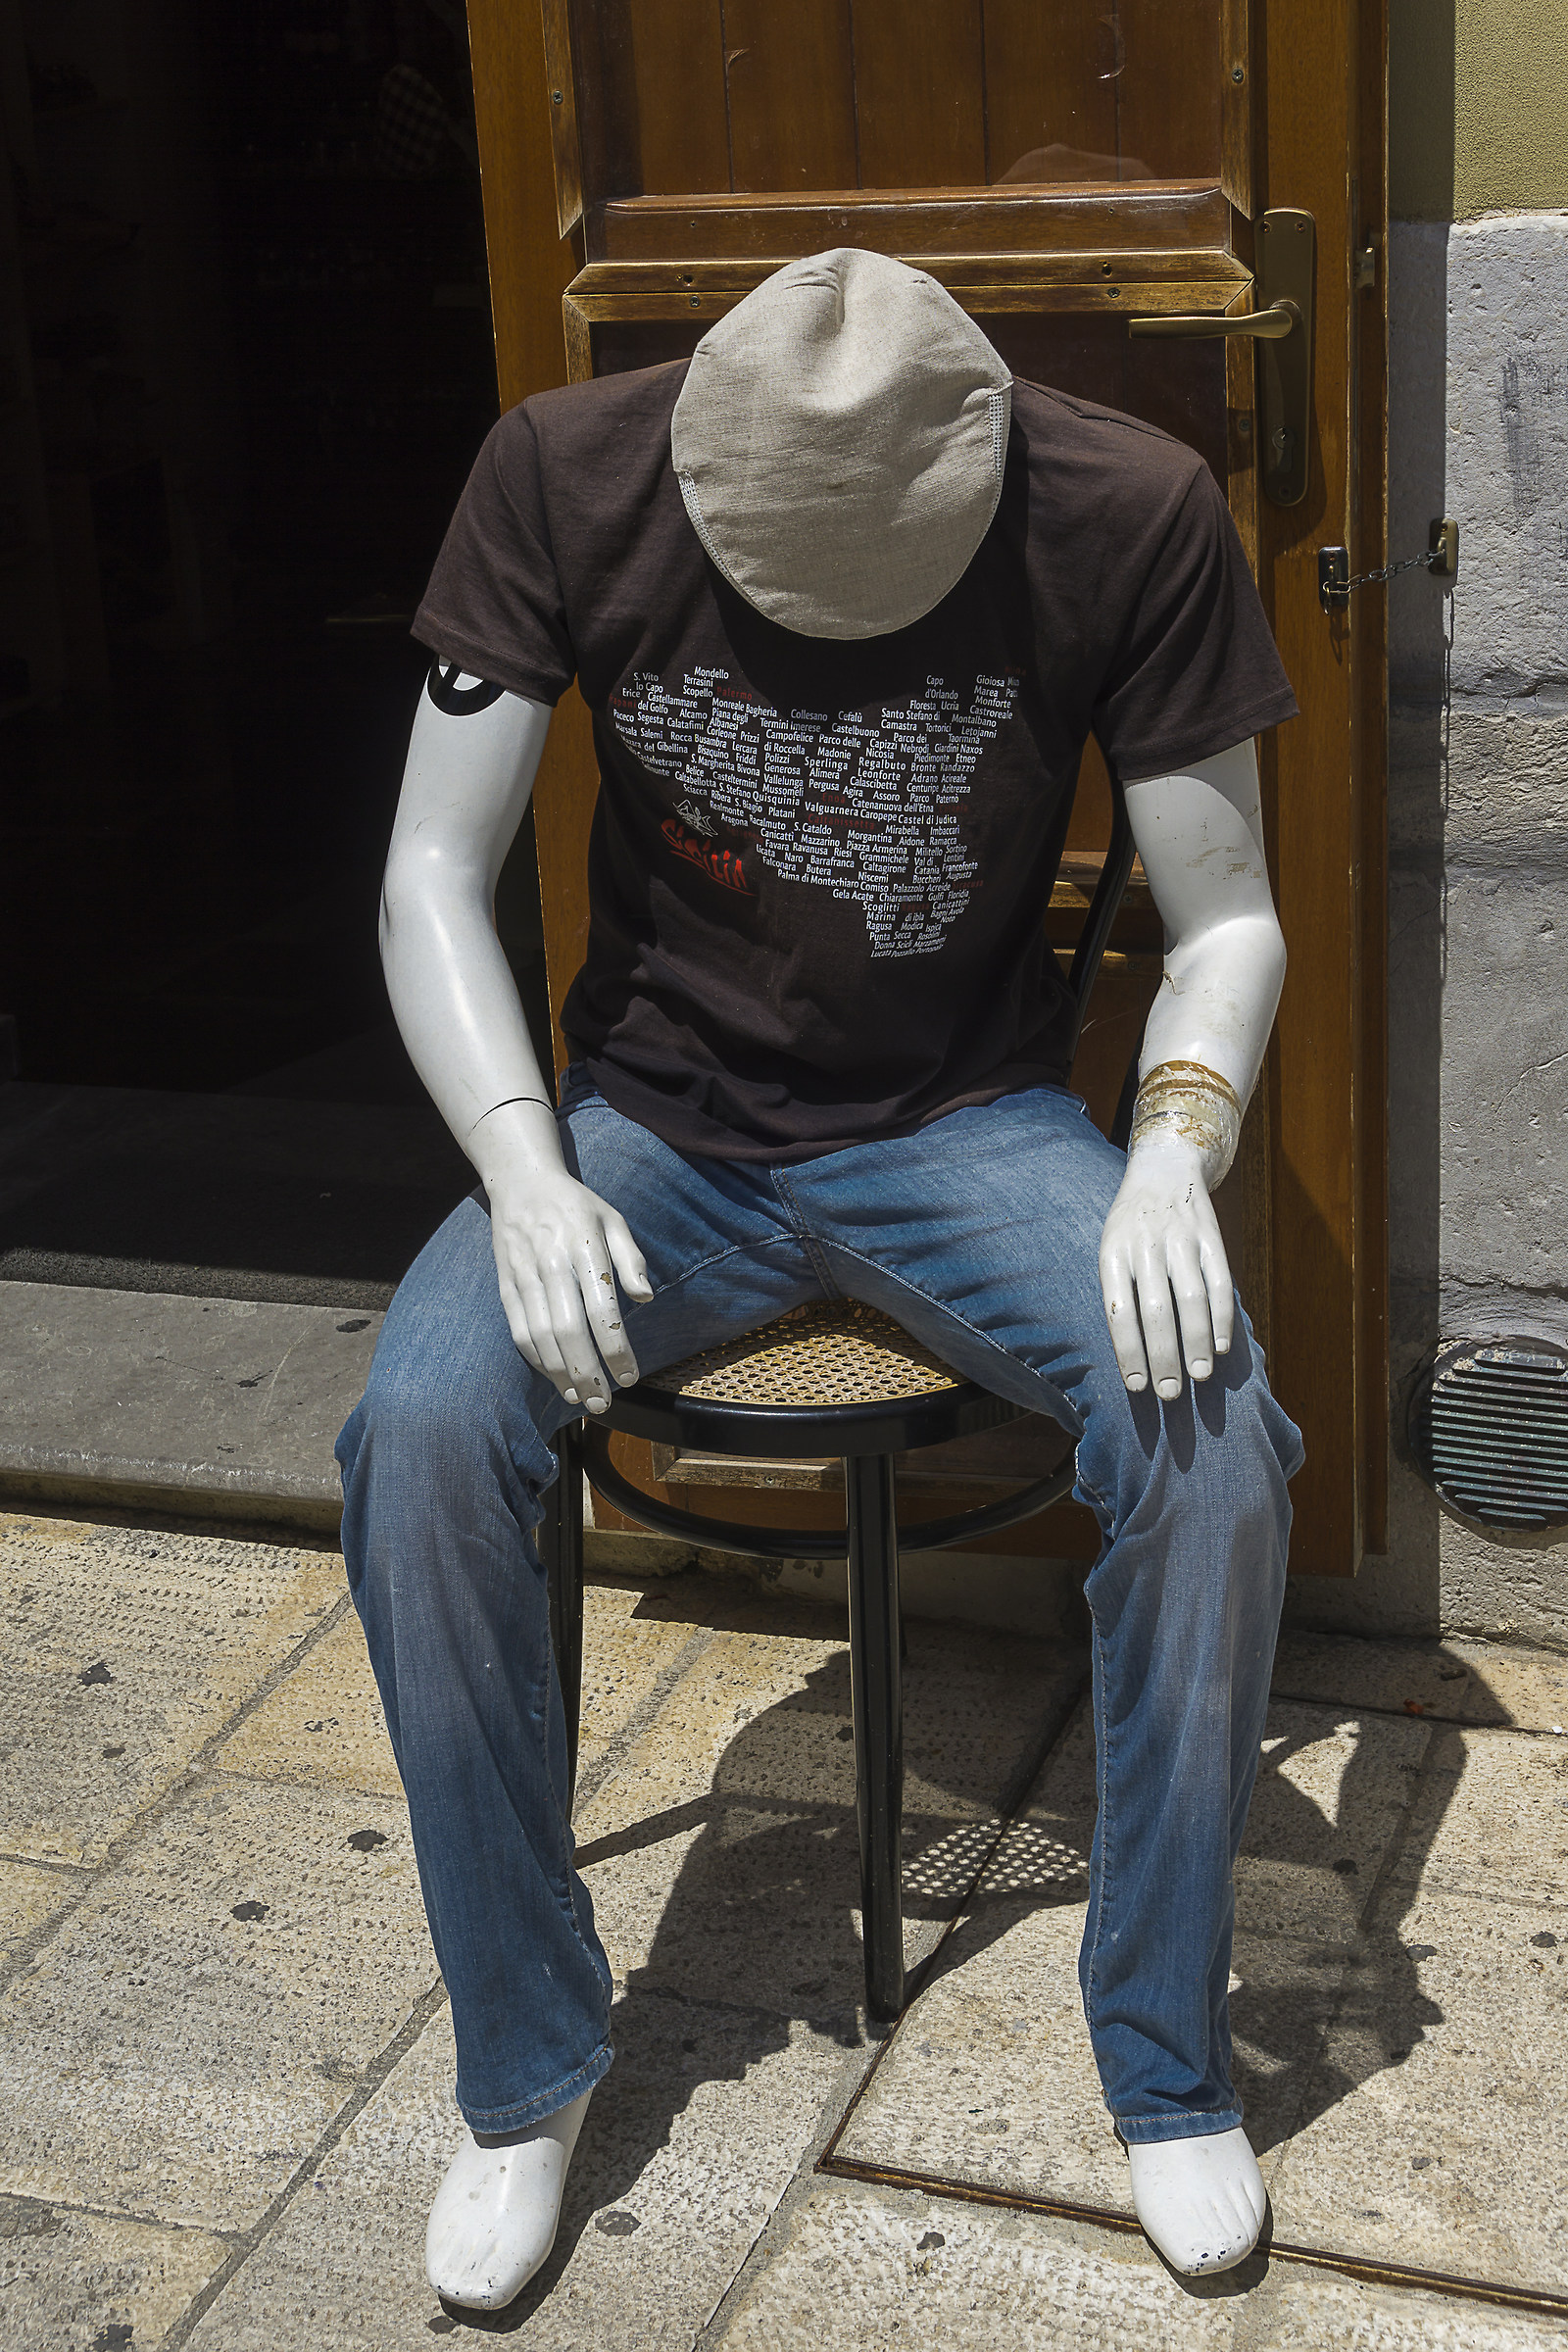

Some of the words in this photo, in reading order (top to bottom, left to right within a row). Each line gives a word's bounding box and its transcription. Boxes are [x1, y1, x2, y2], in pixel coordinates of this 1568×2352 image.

[643, 672, 659, 682] Vito
[683, 674, 713, 687] Terrasini
[694, 666, 729, 679] Mondello
[976, 674, 1005, 687] Gioiosa
[646, 682, 663, 693] Capo
[926, 675, 944, 687] Capo
[622, 688, 640, 698] Erice
[648, 692, 698, 709] Castellammare
[683, 685, 713, 698] Scopello
[974, 685, 999, 697] Marea
[711, 697, 745, 710] Monreale
[746, 704, 777, 717] Bagheria
[909, 700, 936, 710] Floresta
[941, 702, 959, 710] Ucria
[970, 705, 1013, 719] Castroreale
[975, 696, 1011, 709] Monforte
[650, 704, 668, 714] Golfo
[679, 709, 708, 719] Alcamo
[711, 708, 731, 719] Piana
[732, 710, 749, 725] degli
[791, 709, 827, 721] Collesano
[838, 710, 862, 723] Cefalù
[881, 708, 905, 719] Santo
[906, 710, 932, 721] Stefano
[952, 713, 997, 728] Montalbano
[638, 711, 663, 725] Segesta
[667, 717, 704, 730] Calatafimi
[710, 717, 739, 731] Albanesi
[760, 717, 788, 730] Termini
[790, 720, 820, 732] Imerese
[832, 722, 879, 738] Castelbuono
[881, 718, 917, 731] Camastra
[925, 722, 952, 732] Tortorici
[640, 728, 663, 740] Salemi
[671, 731, 692, 742] Rocca
[695, 734, 727, 749] Busambra
[707, 725, 736, 740] Corleone
[740, 731, 760, 743] Prizzi
[766, 729, 813, 743] Campofelice
[819, 733, 841, 745] Parco
[843, 739, 860, 748] delle
[869, 738, 897, 750] Capizzi
[894, 732, 914, 744] Parco
[949, 733, 980, 744] Taormina
[657, 741, 688, 754] Gibellina
[732, 741, 758, 755] Lercara
[774, 743, 805, 755] Roccella
[817, 746, 851, 760] Madonie
[865, 747, 895, 760] Nicosia
[901, 744, 929, 754] Nebrodi
[935, 743, 958, 753] Giardini
[960, 745, 983, 755] Naxos
[698, 756, 734, 771] Margherita
[737, 763, 760, 776] Bivona
[736, 754, 757, 764] Friddi
[764, 753, 790, 763] Polizzi
[805, 757, 848, 771] Sperlinga
[858, 757, 906, 770] Regalbuto
[910, 762, 936, 772] Bronte
[940, 763, 975, 772] Randazzo
[914, 753, 950, 762] Piedimonte
[956, 754, 976, 763] Etneo
[686, 764, 704, 776] Belice
[712, 771, 758, 789] Casteltermini
[764, 762, 801, 775] Generosa
[809, 767, 840, 779] Alimera
[858, 767, 901, 781] Leonforte
[911, 774, 938, 783] Adrano
[941, 773, 966, 783] Acireale
[763, 773, 804, 789] Vallelunga
[808, 778, 839, 792] Pergusa
[850, 776, 898, 791] Calascibetta
[942, 784, 970, 793] Acitrezza
[683, 783, 708, 795] Sciacca
[710, 789, 731, 803] Ribera
[742, 799, 762, 813] Biagio
[768, 807, 795, 818] Platani
[726, 784, 751, 799] Stefano
[752, 791, 800, 806] Quisquinia
[762, 783, 804, 797] Mussomeli
[843, 786, 863, 799] Agira
[873, 790, 900, 802] Assoro
[910, 794, 929, 803] Parco
[852, 798, 902, 811] Catenanuova
[710, 800, 744, 816] Realmonte
[749, 814, 786, 830] Racalmuto
[803, 822, 832, 835] Cataldo
[805, 802, 858, 816] Valguarnera
[860, 808, 897, 822] Caropepe
[898, 814, 923, 824] Castel
[936, 814, 956, 825] Judica
[721, 813, 748, 827] Aragona
[760, 828, 794, 841] Canicattì
[801, 834, 840, 847] Mazzarino
[848, 829, 892, 843] Morgantina
[899, 837, 925, 847] Aidone
[885, 825, 919, 835] Mirabella
[930, 825, 959, 836] Imbaccari
[765, 839, 790, 851] Favara
[793, 843, 828, 855] Ravanusa
[834, 848, 852, 858] Riesi
[847, 840, 870, 852] Piazza
[872, 843, 907, 855] Armerina
[757, 844, 775, 858] Licata
[785, 853, 803, 862] Naro
[810, 855, 855, 868] Barrafranca
[859, 852, 908, 863] Grammichele
[762, 857, 796, 871] Falconara
[807, 863, 831, 875] Butera
[862, 862, 906, 874] Caltagirone
[914, 865, 940, 875] Catania
[777, 868, 800, 881] Palma
[810, 875, 858, 888] Montechiaro
[860, 882, 889, 892] Comiso
[893, 883, 924, 893] Palazzolo
[858, 871, 888, 883] Niscemi
[912, 874, 941, 883] Buccheri
[833, 889, 850, 900] Gela
[852, 891, 874, 902] Acate
[879, 893, 923, 902] Chiaramonte
[928, 892, 944, 902] Gulfi
[862, 901, 900, 913] Scoglitti
[866, 911, 896, 921] Marina
[866, 921, 892, 932] Ragusa
[901, 922, 923, 931] Modica
[869, 931, 890, 941] Punta
[894, 931, 911, 940] Secca
